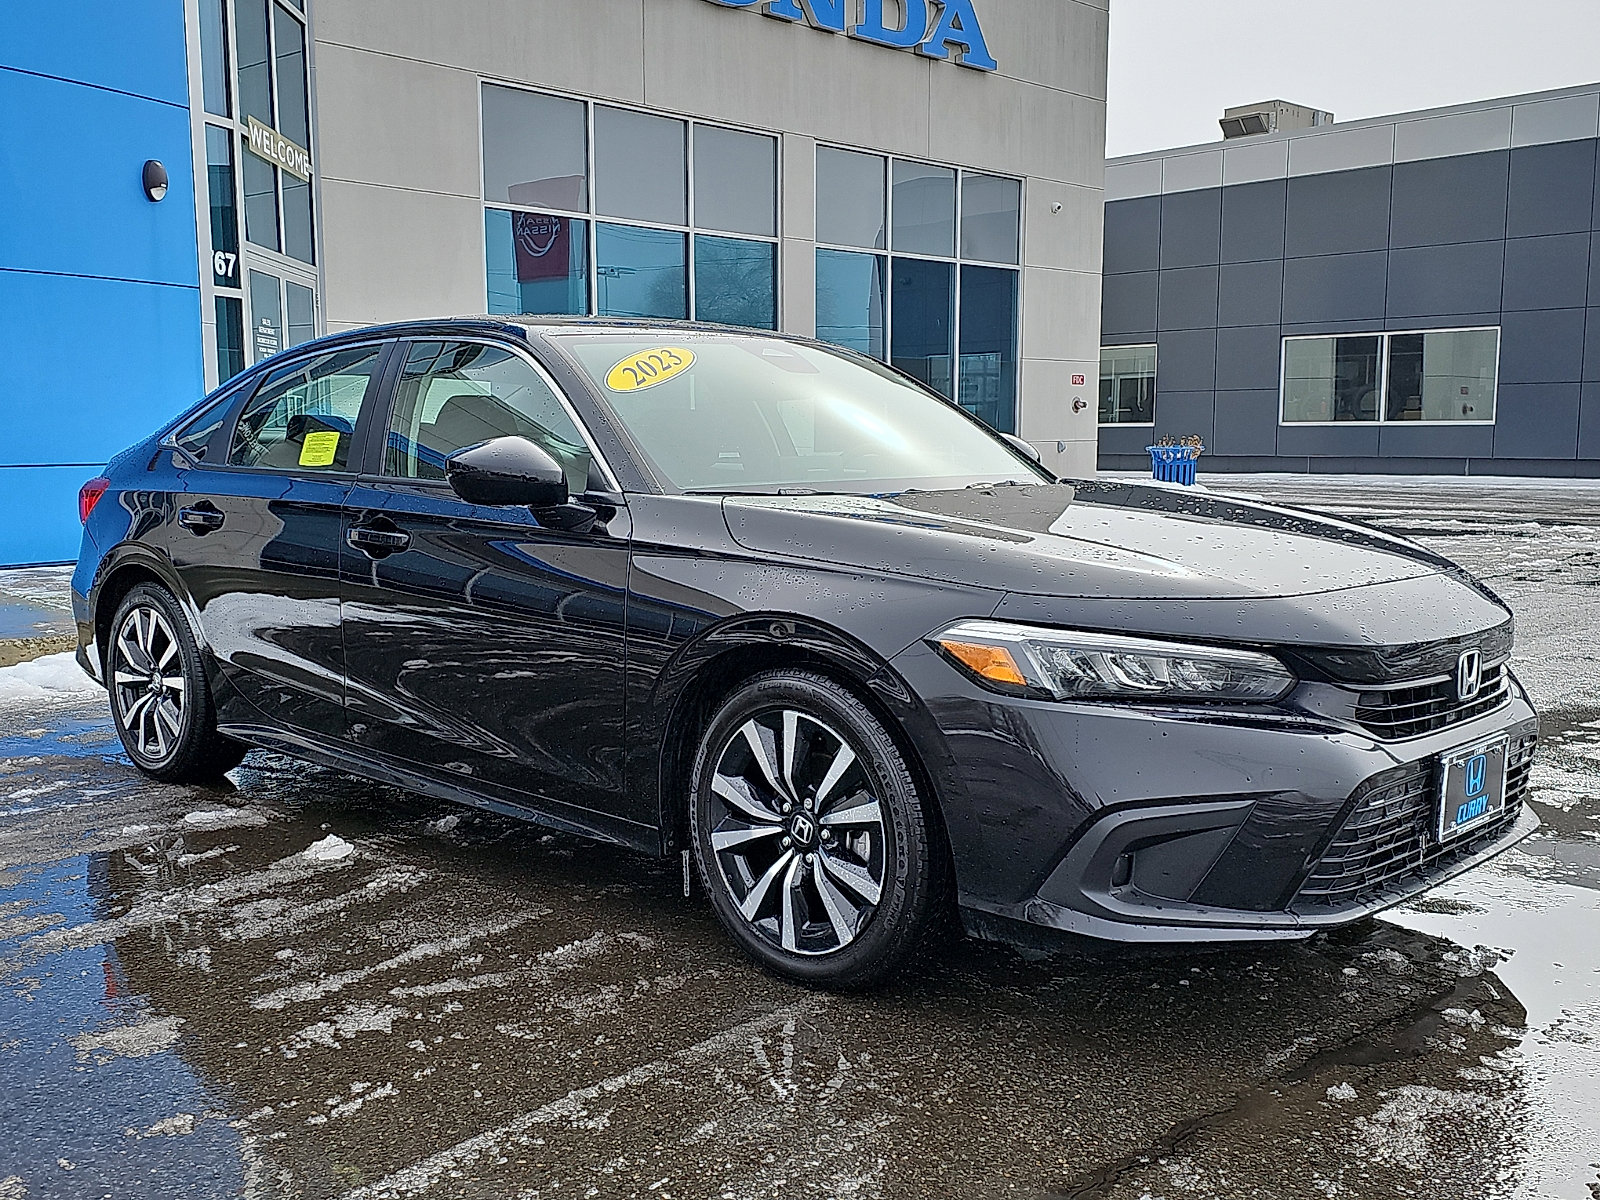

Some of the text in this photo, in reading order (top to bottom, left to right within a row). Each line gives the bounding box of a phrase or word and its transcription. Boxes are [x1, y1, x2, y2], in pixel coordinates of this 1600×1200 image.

[248, 121, 309, 178] WELCOME
[214, 251, 236, 277] 67
[623, 350, 682, 386] 2023
[1457, 794, 1490, 825] CURRY
